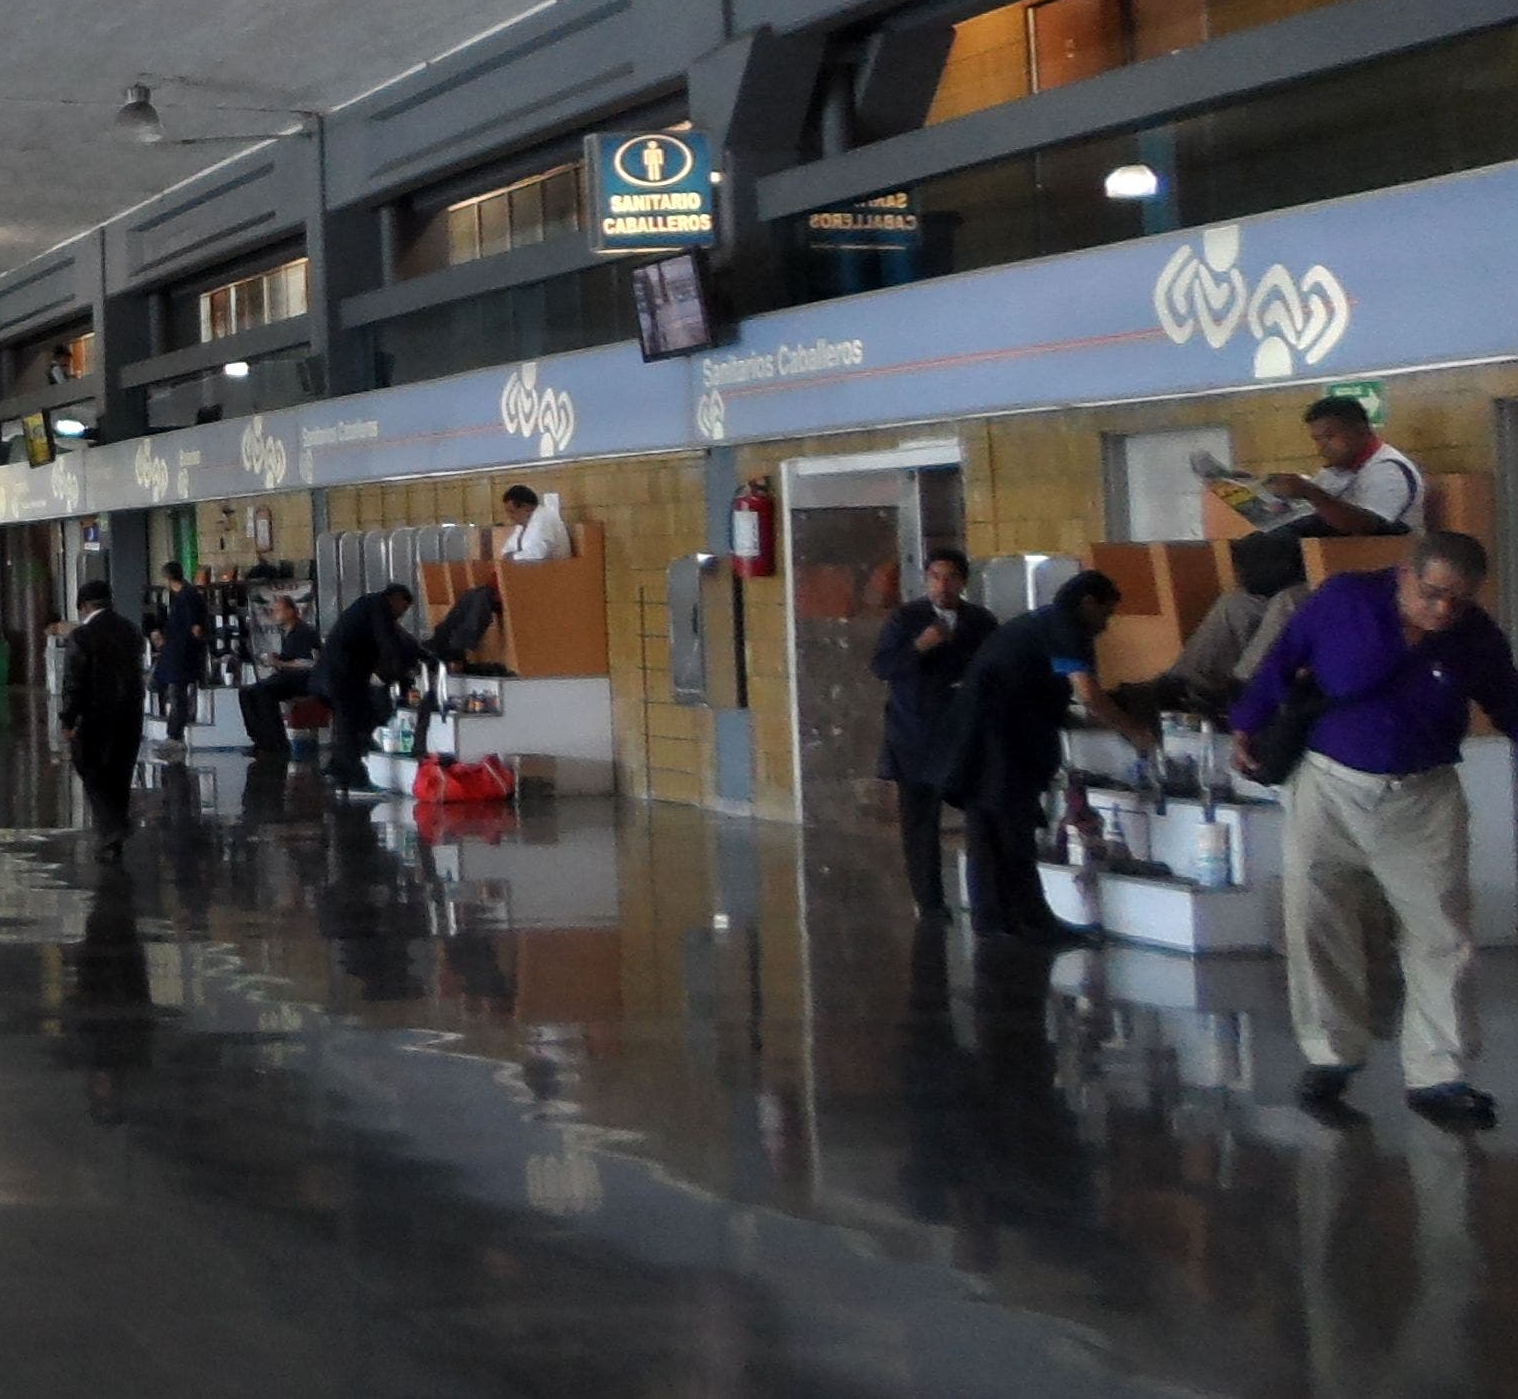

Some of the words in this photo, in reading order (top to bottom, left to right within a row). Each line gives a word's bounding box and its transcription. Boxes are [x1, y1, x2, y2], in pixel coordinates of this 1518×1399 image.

[610, 193, 701, 212] SANITARIO
[603, 214, 712, 234] CABALLEROS
[778, 338, 863, 375] Caballeros
